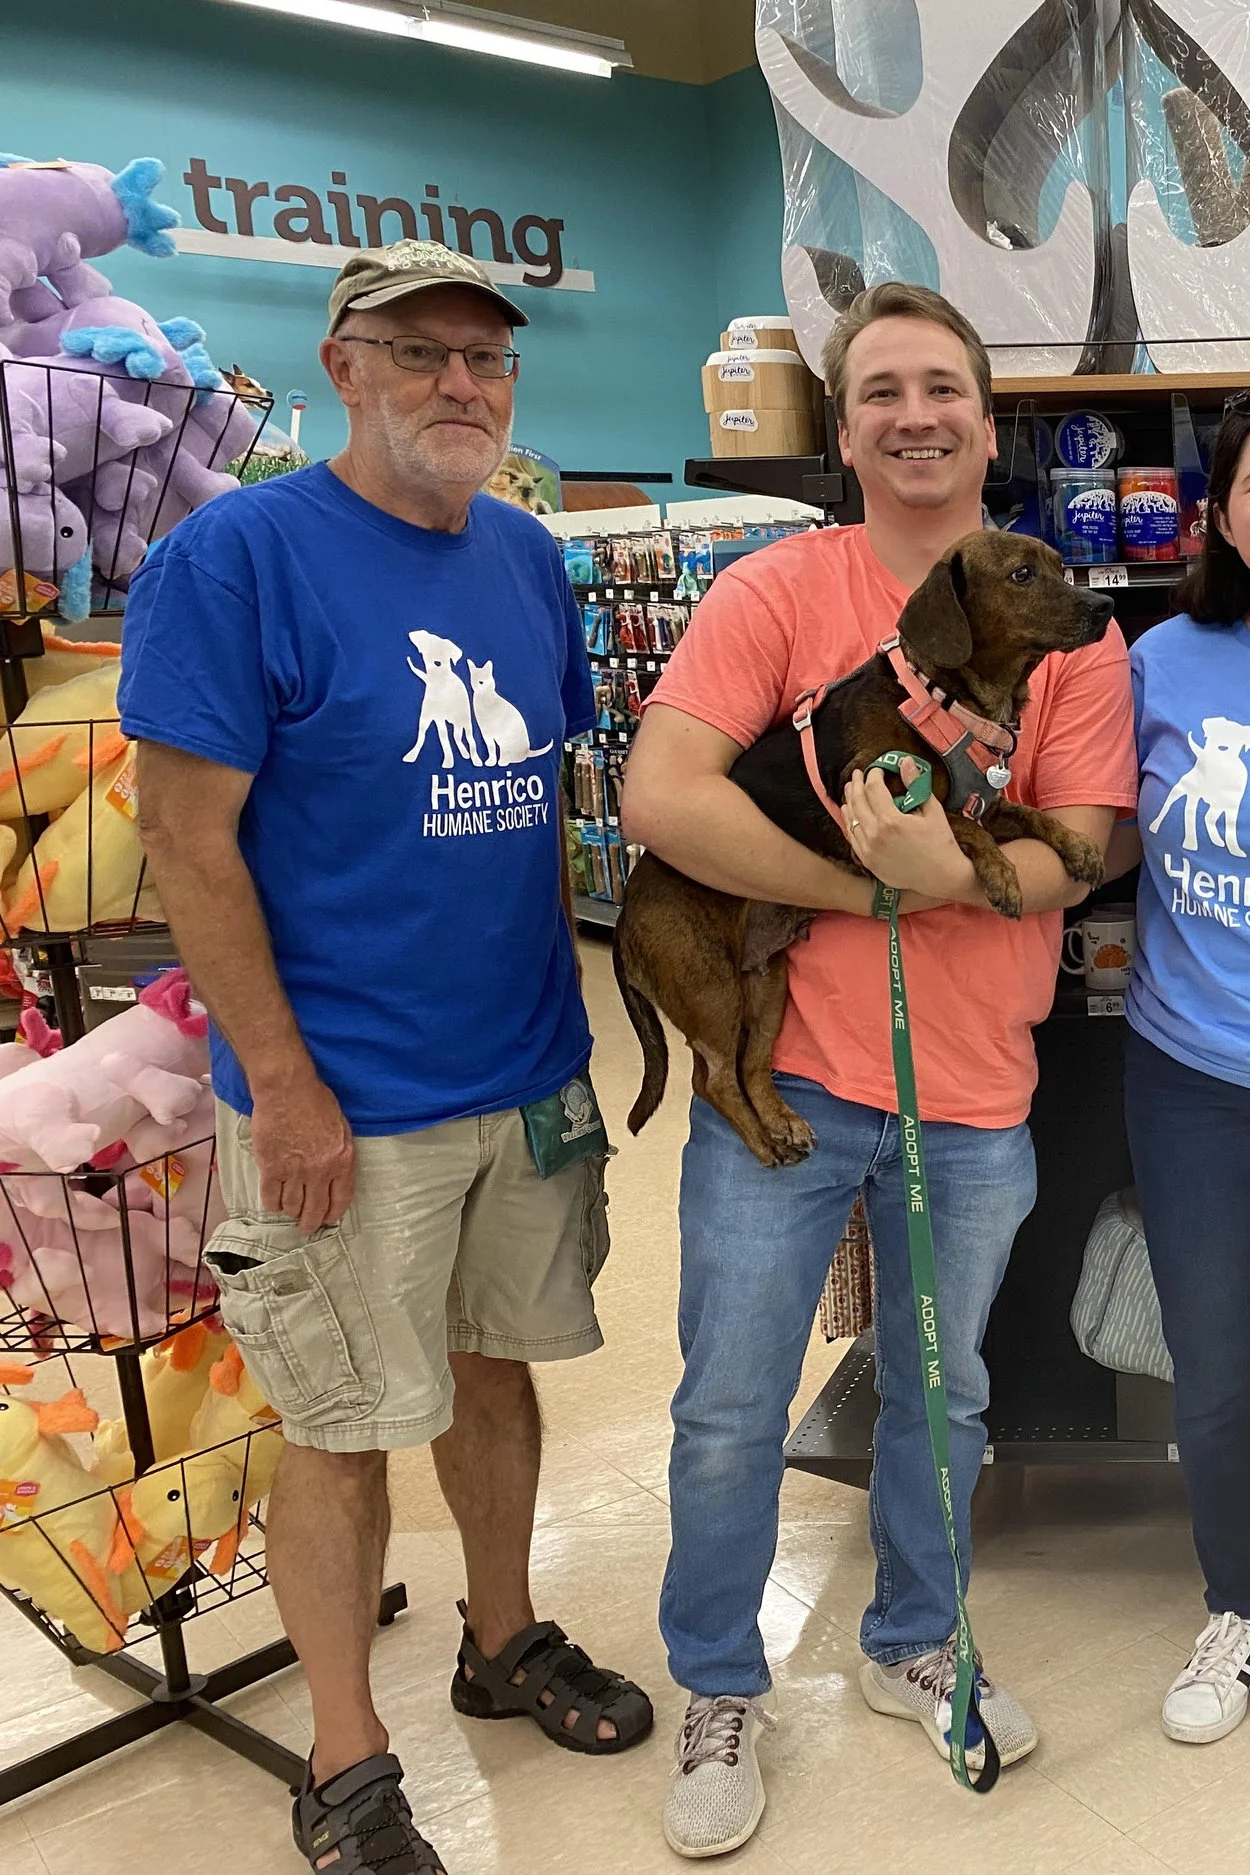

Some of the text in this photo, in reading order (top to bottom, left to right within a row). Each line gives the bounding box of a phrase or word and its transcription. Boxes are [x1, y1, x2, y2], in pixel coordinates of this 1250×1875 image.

[183, 157, 565, 287] training
[525, 448, 542, 461] First
[423, 802, 549, 837] HUMANE SOCIETY
[431, 771, 544, 811] Henrico
[890, 926, 905, 1030] ADOPT ME
[903, 1114, 924, 1213] ADOPT ME
[920, 1294, 941, 1389] ADOPT ME
[940, 1467, 954, 1521] ADOPT
